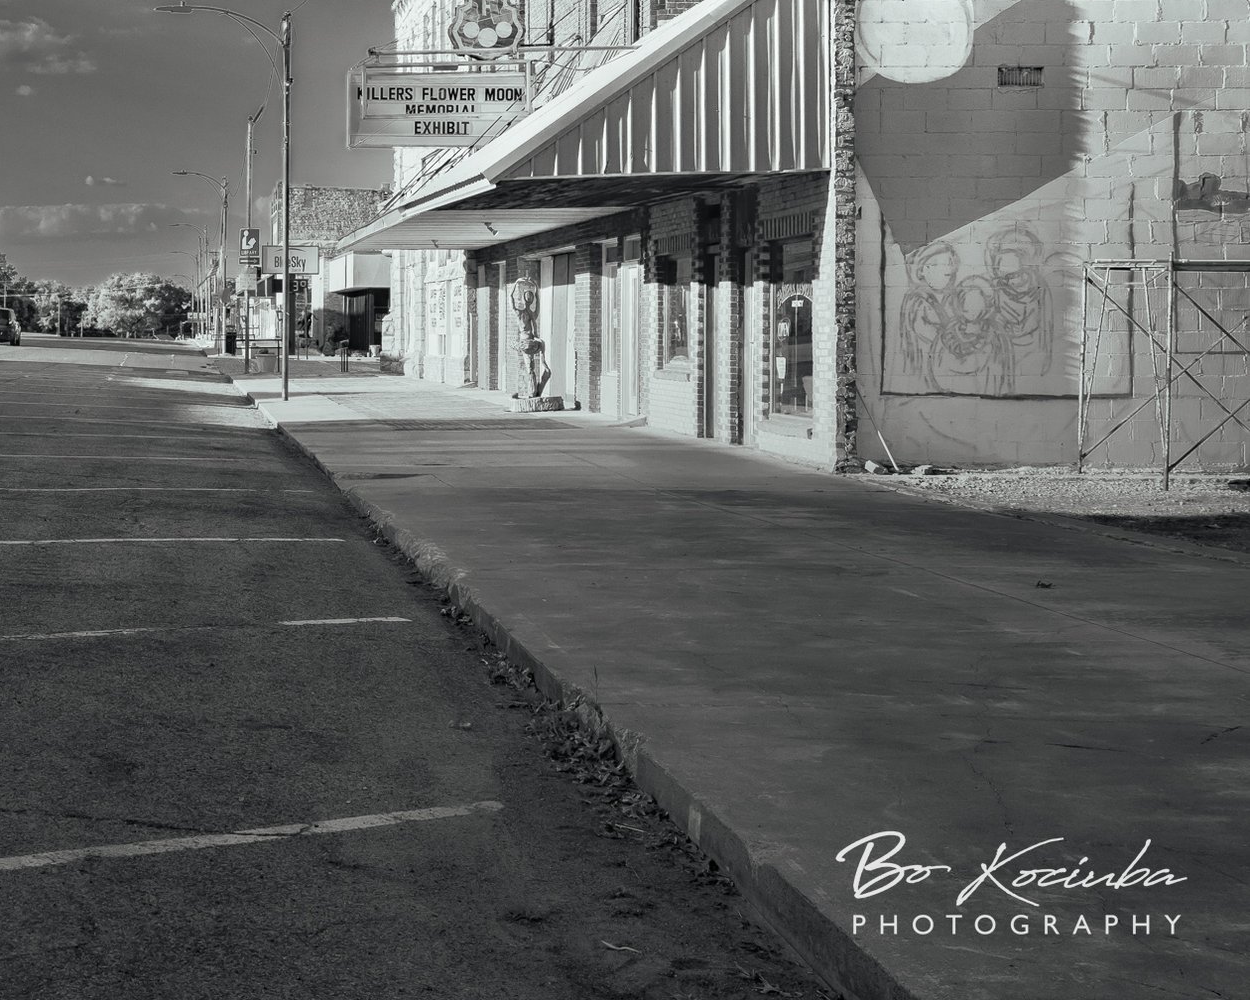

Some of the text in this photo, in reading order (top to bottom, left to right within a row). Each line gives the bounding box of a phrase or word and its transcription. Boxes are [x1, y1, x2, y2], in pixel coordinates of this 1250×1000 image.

[357, 87, 523, 101] KILLERS FLOWER MOON
[414, 121, 470, 135] EXHIBIT
